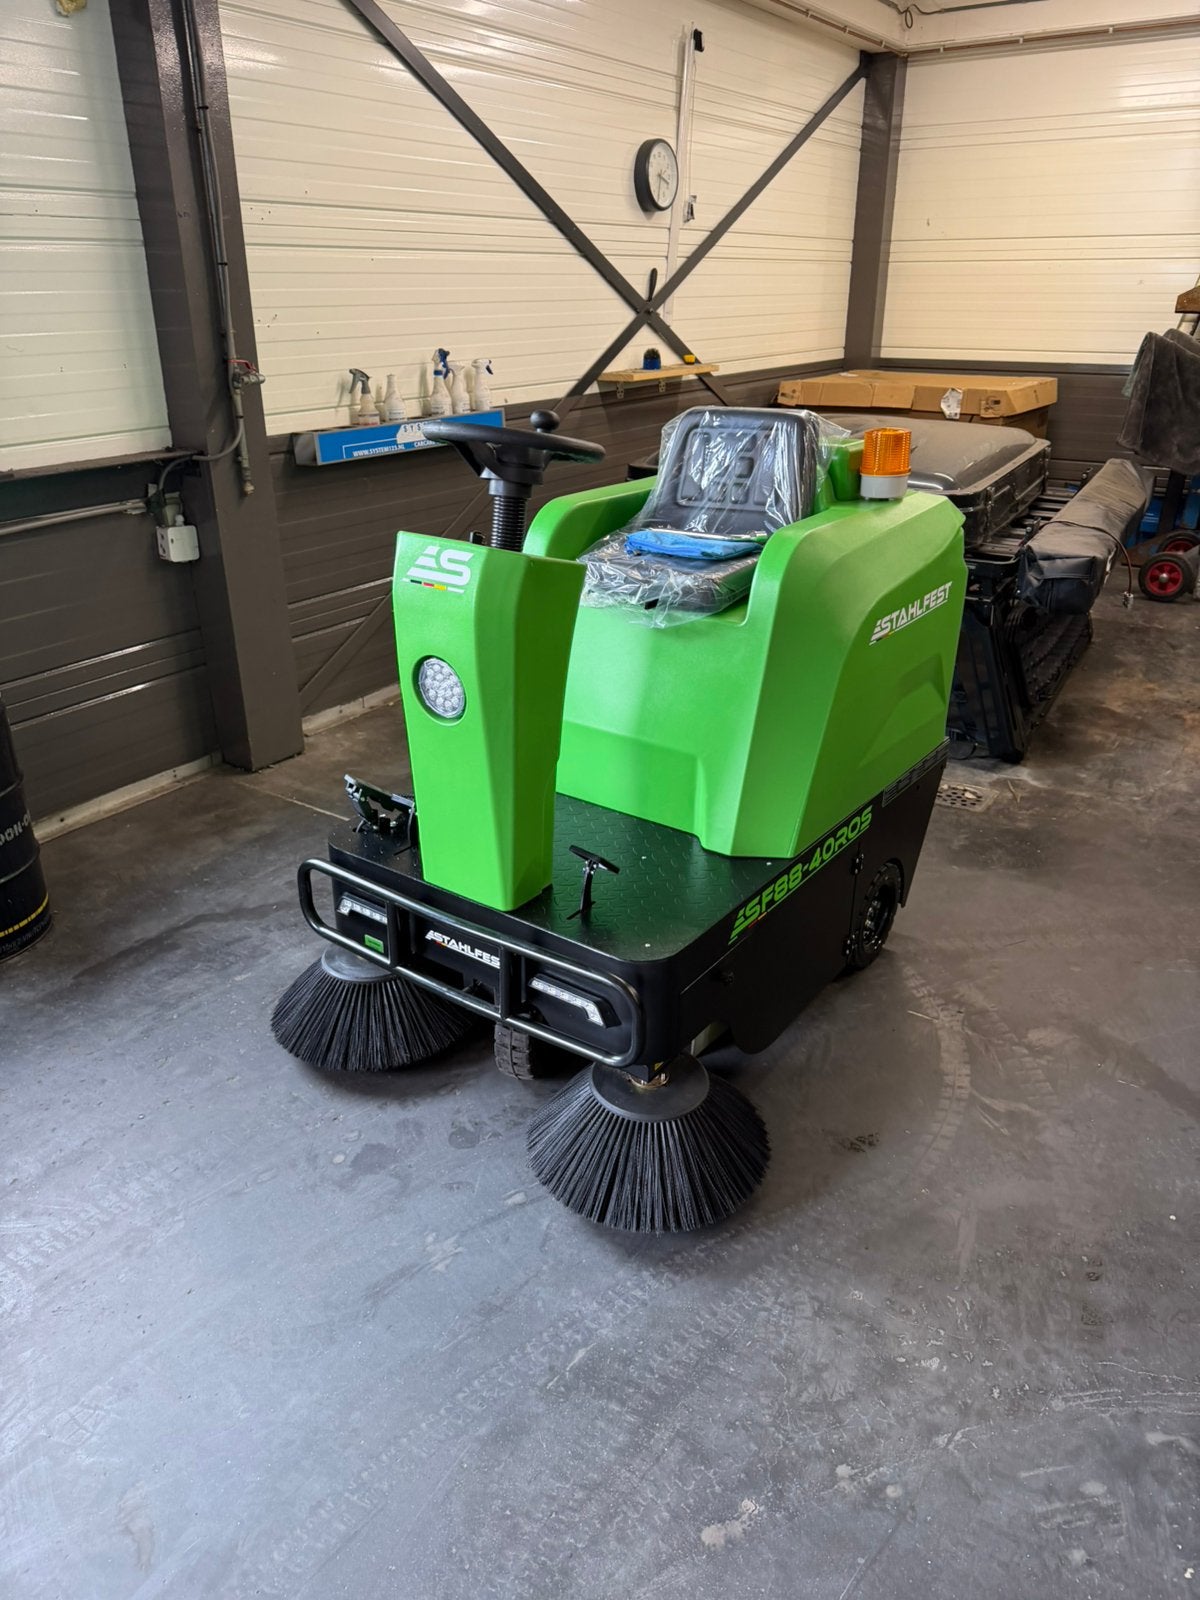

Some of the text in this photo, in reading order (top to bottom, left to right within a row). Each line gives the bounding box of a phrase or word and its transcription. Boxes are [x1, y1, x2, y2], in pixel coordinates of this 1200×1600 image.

[869, 580, 953, 642] STAHLFEST
[729, 805, 873, 940] SF88-40ROS
[425, 930, 501, 968] STAHLFES
